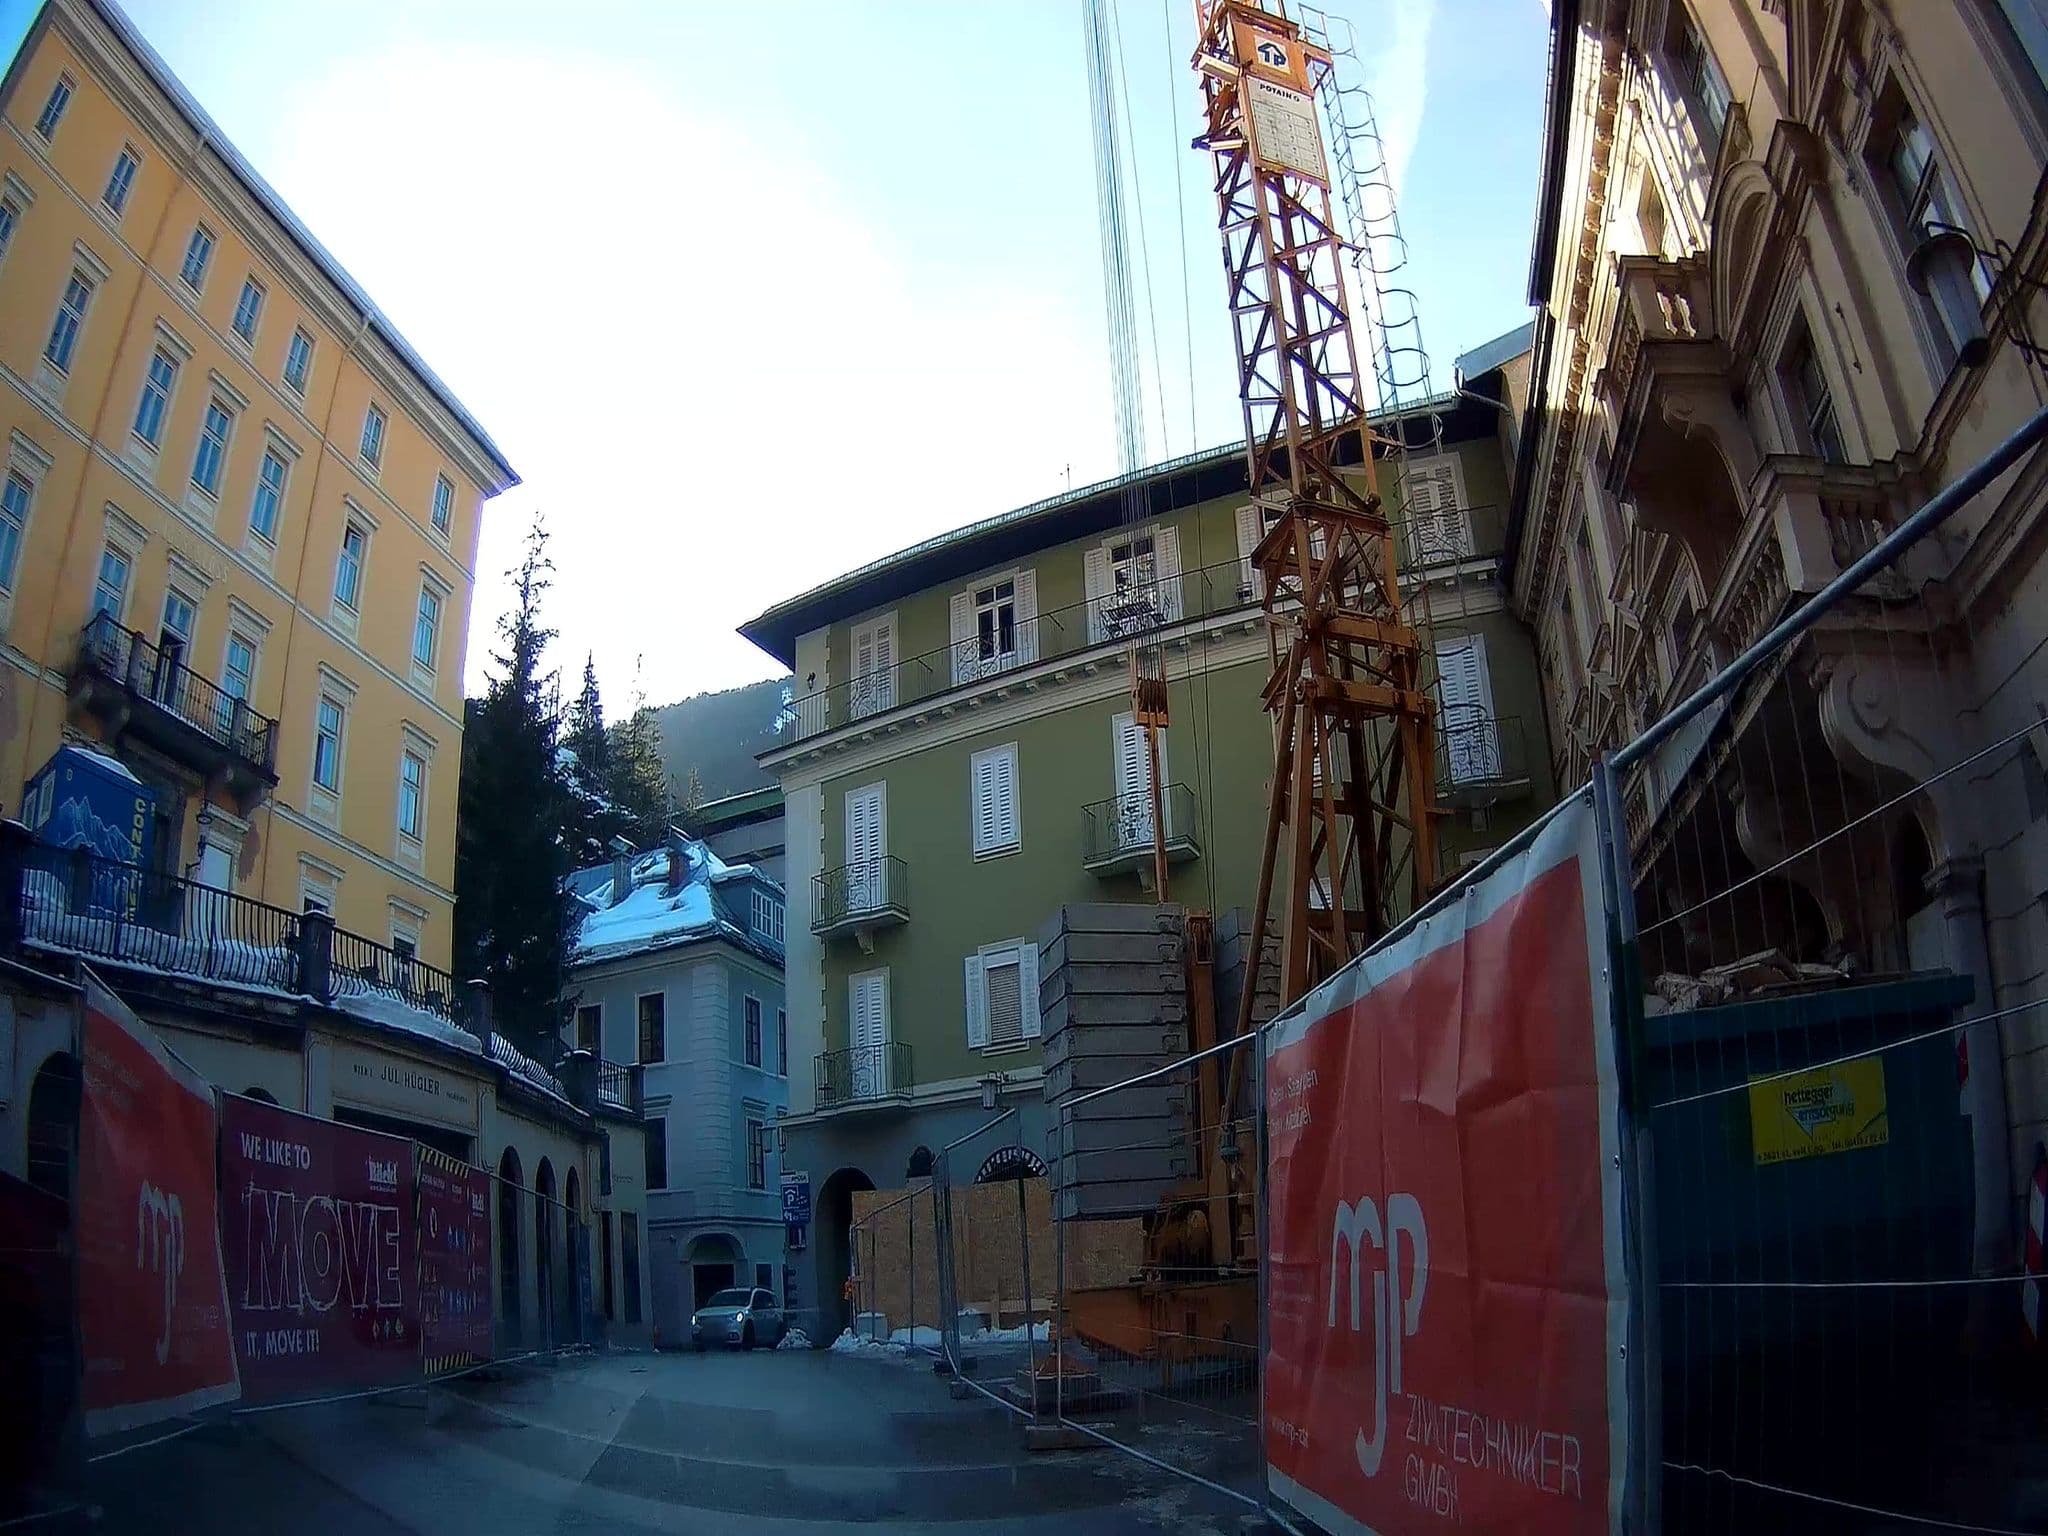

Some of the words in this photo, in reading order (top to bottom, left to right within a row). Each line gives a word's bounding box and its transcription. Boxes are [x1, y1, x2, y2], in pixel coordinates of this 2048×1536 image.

[1260, 83, 1291, 100] POTAIN
[241, 1132, 261, 1161] WE
[265, 1138, 292, 1166] LIKE
[295, 1144, 311, 1170] TO
[242, 1180, 402, 1315] MOVE
[246, 1329, 261, 1360] IT,
[265, 1328, 304, 1356] MOVE
[305, 1327, 320, 1352] IT!
